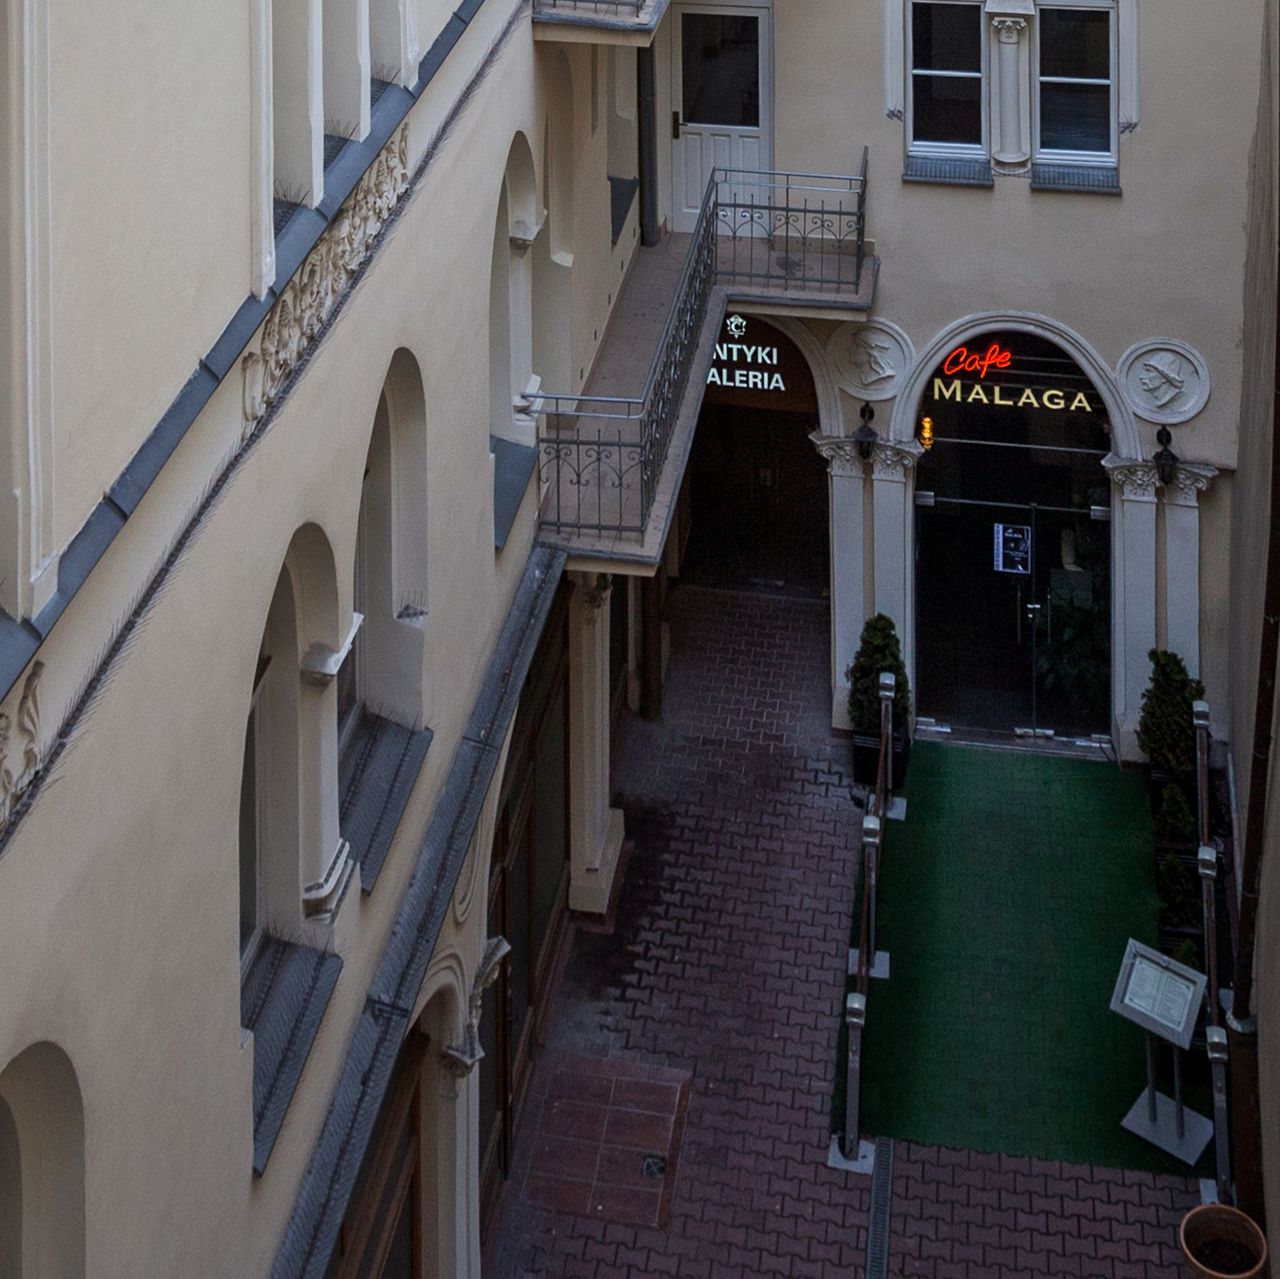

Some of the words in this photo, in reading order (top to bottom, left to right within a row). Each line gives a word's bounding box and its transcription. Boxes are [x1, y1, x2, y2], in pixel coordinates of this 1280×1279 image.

[712, 343, 778, 365] NTYKI
[944, 343, 1012, 379] Cafe
[706, 367, 786, 391] ALERIA
[933, 377, 1093, 413] MALAGA
